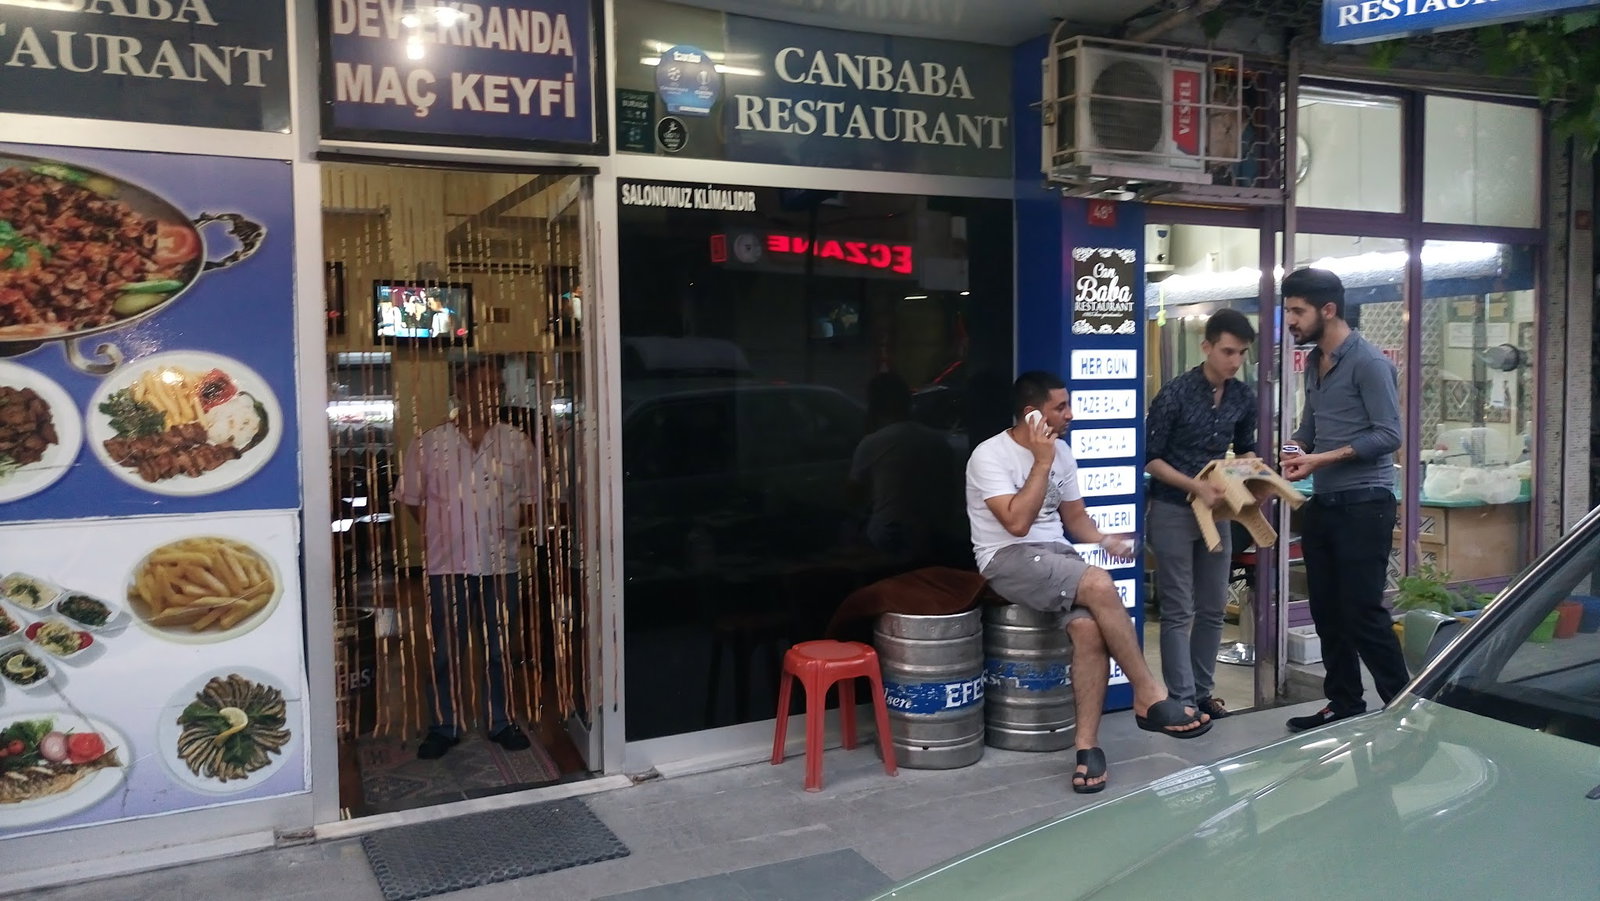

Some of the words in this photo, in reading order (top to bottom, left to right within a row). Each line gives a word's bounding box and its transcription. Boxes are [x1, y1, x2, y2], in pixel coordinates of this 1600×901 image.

[0, 22, 273, 88] AURANT
[774, 47, 975, 100] CANBABA
[336, 62, 438, 118] MAÇ
[450, 72, 576, 118] KEYFİ
[1178, 80, 1192, 134] VESTEL
[735, 94, 1008, 150] RESTAURANT
[621, 183, 693, 208] SALONUMUZ
[693, 184, 756, 212] KLİMALIDIR
[1075, 275, 1133, 303] Baba
[1093, 262, 1117, 279] Can
[1074, 301, 1135, 312] RESTAURANT
[1081, 357, 1102, 376] HER
